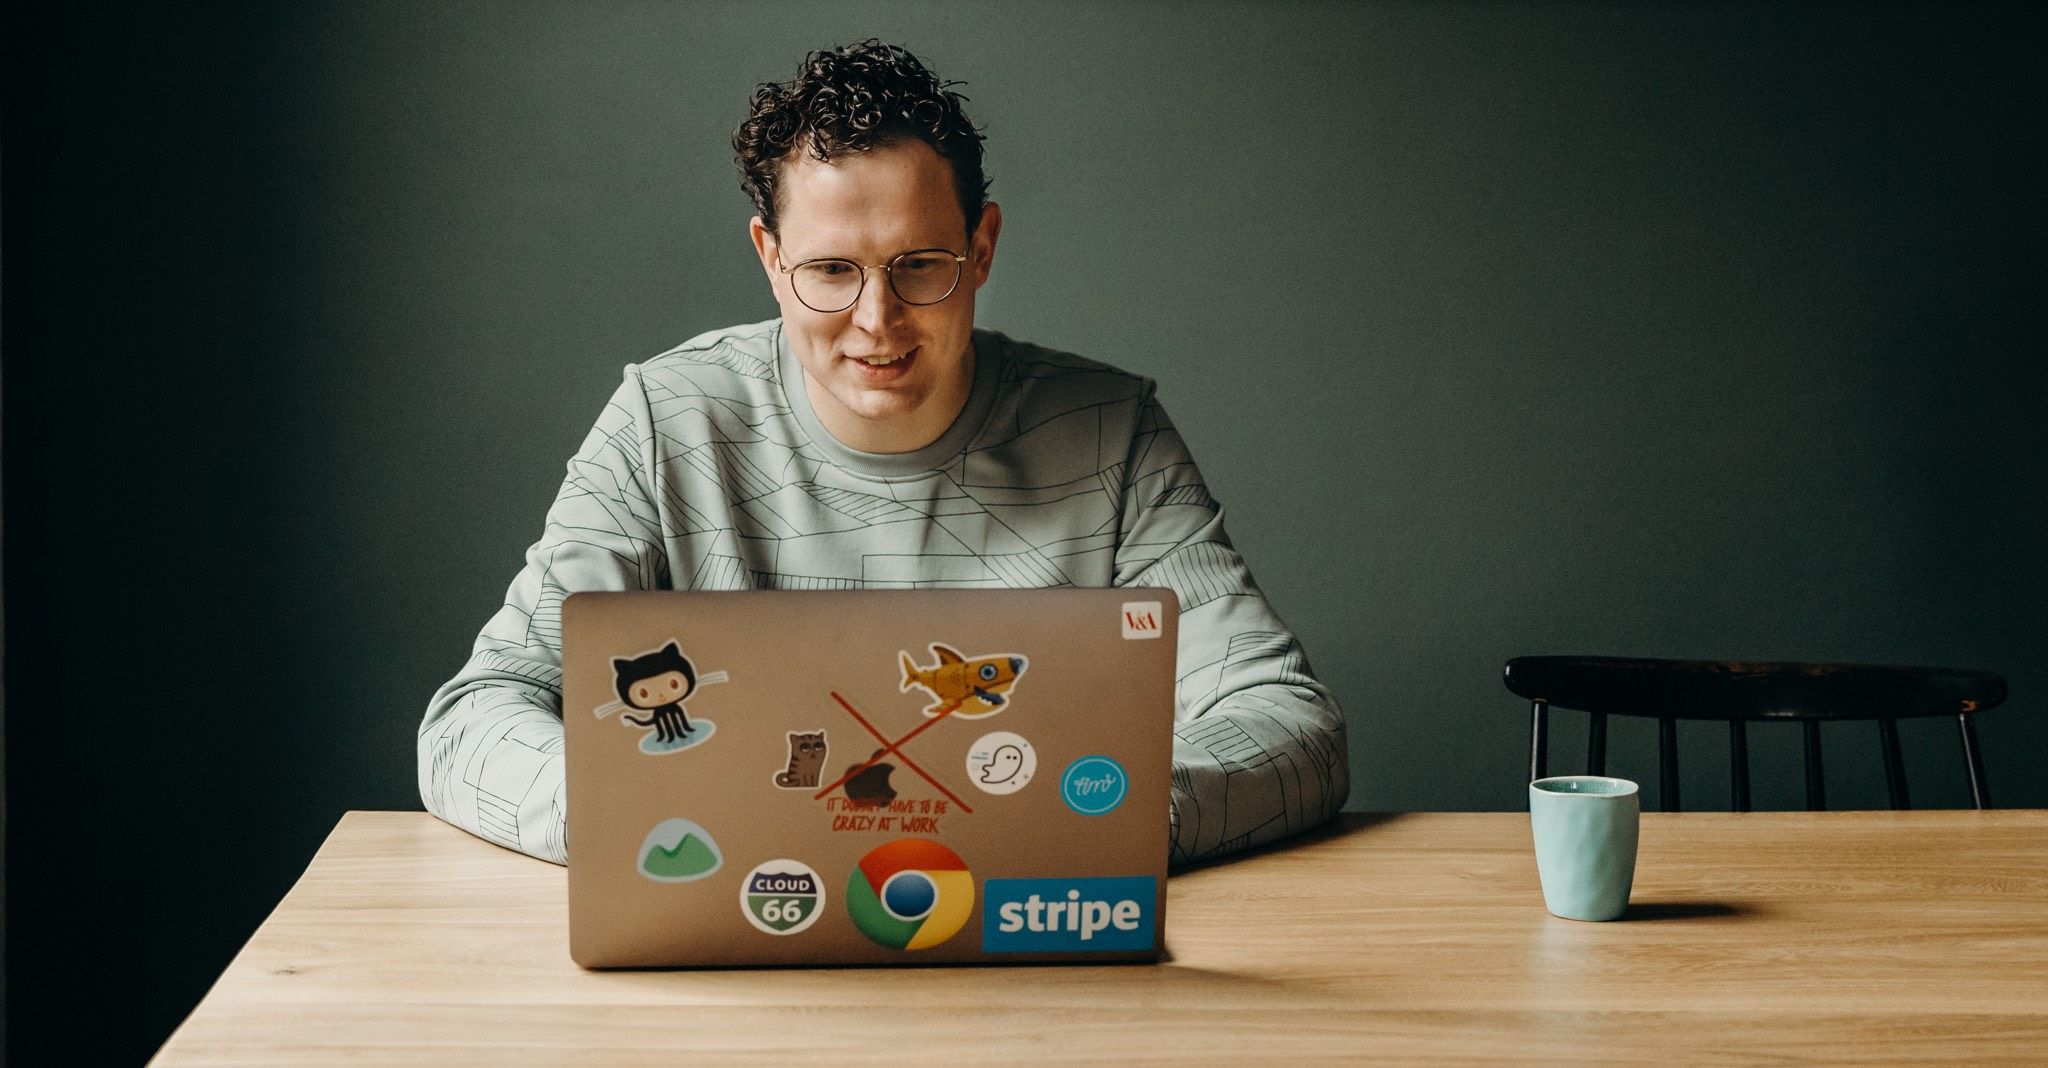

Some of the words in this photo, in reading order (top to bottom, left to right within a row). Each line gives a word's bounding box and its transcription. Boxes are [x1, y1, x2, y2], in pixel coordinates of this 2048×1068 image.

[887, 799, 915, 813] HAVE
[919, 799, 932, 814] TO
[934, 800, 949, 814] BE
[832, 815, 876, 832] CRAZY
[877, 816, 898, 832] AT
[901, 815, 940, 834] WORK
[755, 878, 811, 892] CLOUD
[761, 898, 802, 923] 66
[998, 888, 1142, 941] stripe
